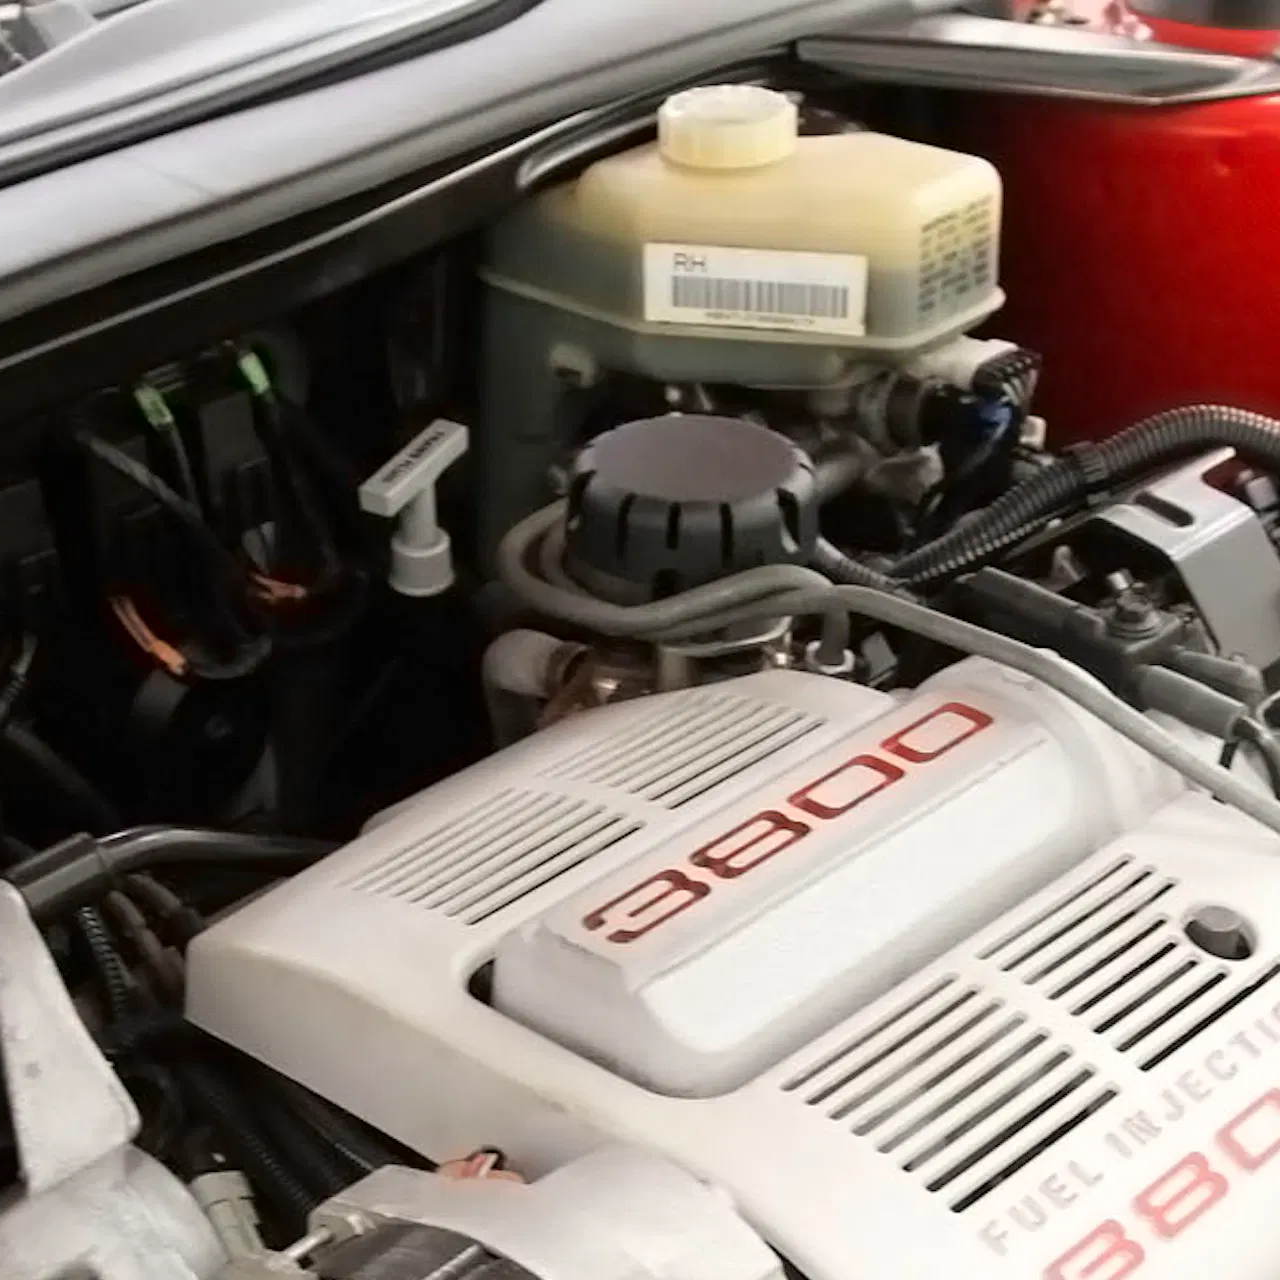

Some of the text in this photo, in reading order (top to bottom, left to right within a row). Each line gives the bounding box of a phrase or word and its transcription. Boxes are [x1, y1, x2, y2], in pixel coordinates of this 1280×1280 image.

[673, 252, 708, 273] RH
[583, 702, 994, 943] 3800
[977, 1159, 1104, 1256] FUEL
